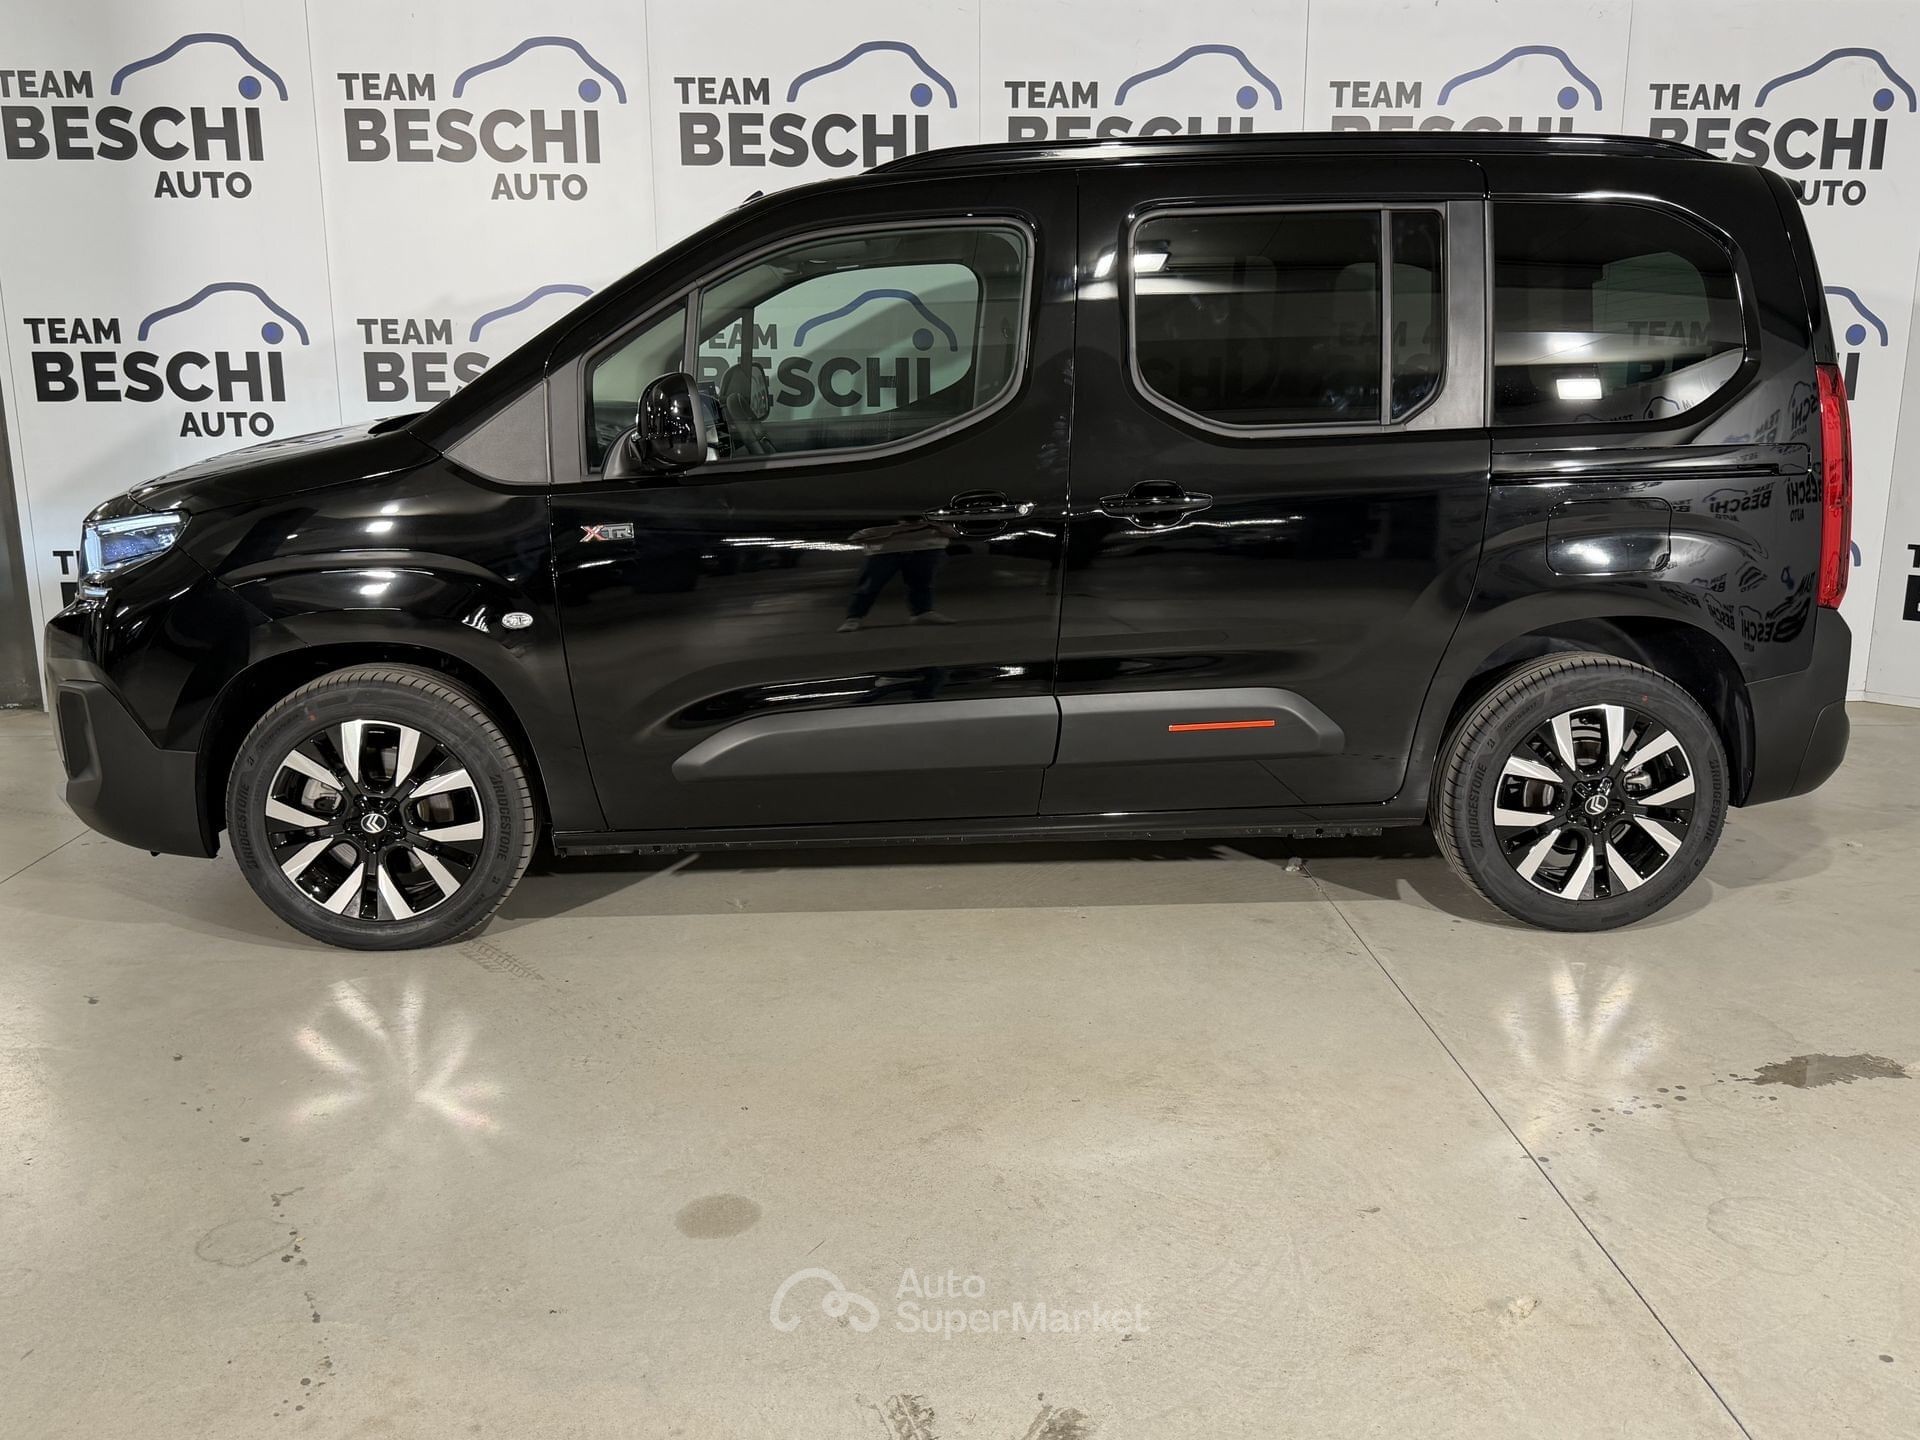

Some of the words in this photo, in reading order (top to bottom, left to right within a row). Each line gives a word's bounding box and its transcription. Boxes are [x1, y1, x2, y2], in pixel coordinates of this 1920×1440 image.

[0, 70, 93, 98] TEAM
[338, 73, 435, 100] TEAM
[674, 77, 769, 105] TEAM
[1005, 81, 1098, 108] TEAM
[1330, 81, 1421, 108] TEAM
[1650, 84, 1740, 110] TEAM
[1, 106, 264, 161] BESCHI
[344, 109, 600, 163] BESCHI
[679, 112, 929, 168] BESCHI
[155, 171, 251, 198] AUTO
[491, 174, 587, 200] AUTO
[1798, 180, 1866, 206] UTO
[23, 318, 121, 344] TEAM
[357, 319, 453, 345] TEAM
[708, 324, 777, 350] EAM
[31, 351, 286, 402] BESCHI
[363, 352, 489, 402] BES
[180, 412, 274, 437] AUTO
[580, 523, 634, 542] XTR
[1468, 762, 1487, 849] BRIDGESTONE
